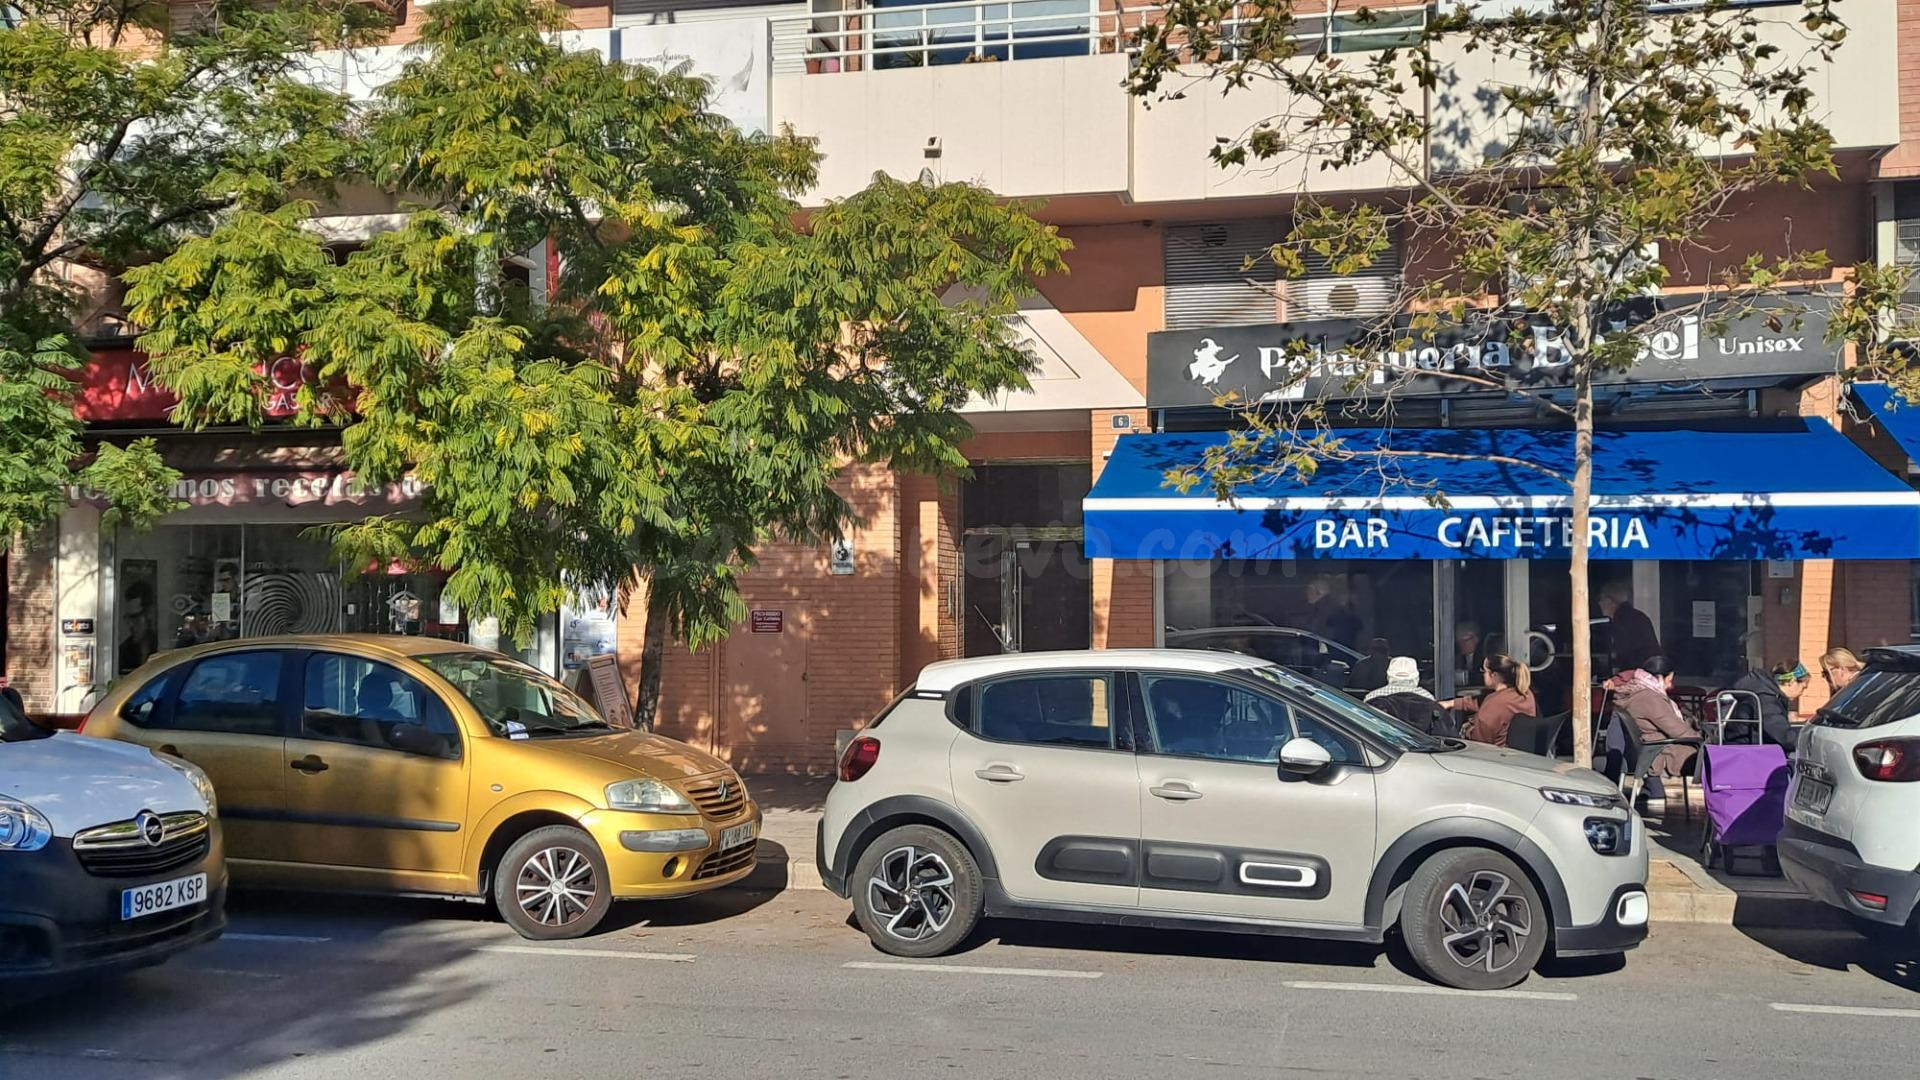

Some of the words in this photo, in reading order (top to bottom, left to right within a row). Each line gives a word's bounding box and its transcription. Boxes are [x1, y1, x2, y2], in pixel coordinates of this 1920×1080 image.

[1718, 336, 1804, 355] Unisex
[1118, 417, 1124, 426] 6
[1315, 517, 1389, 549] BAR
[1437, 517, 1650, 548] CAFETERIA
[135, 885, 173, 913] 9682
[178, 878, 203, 903] KSP
